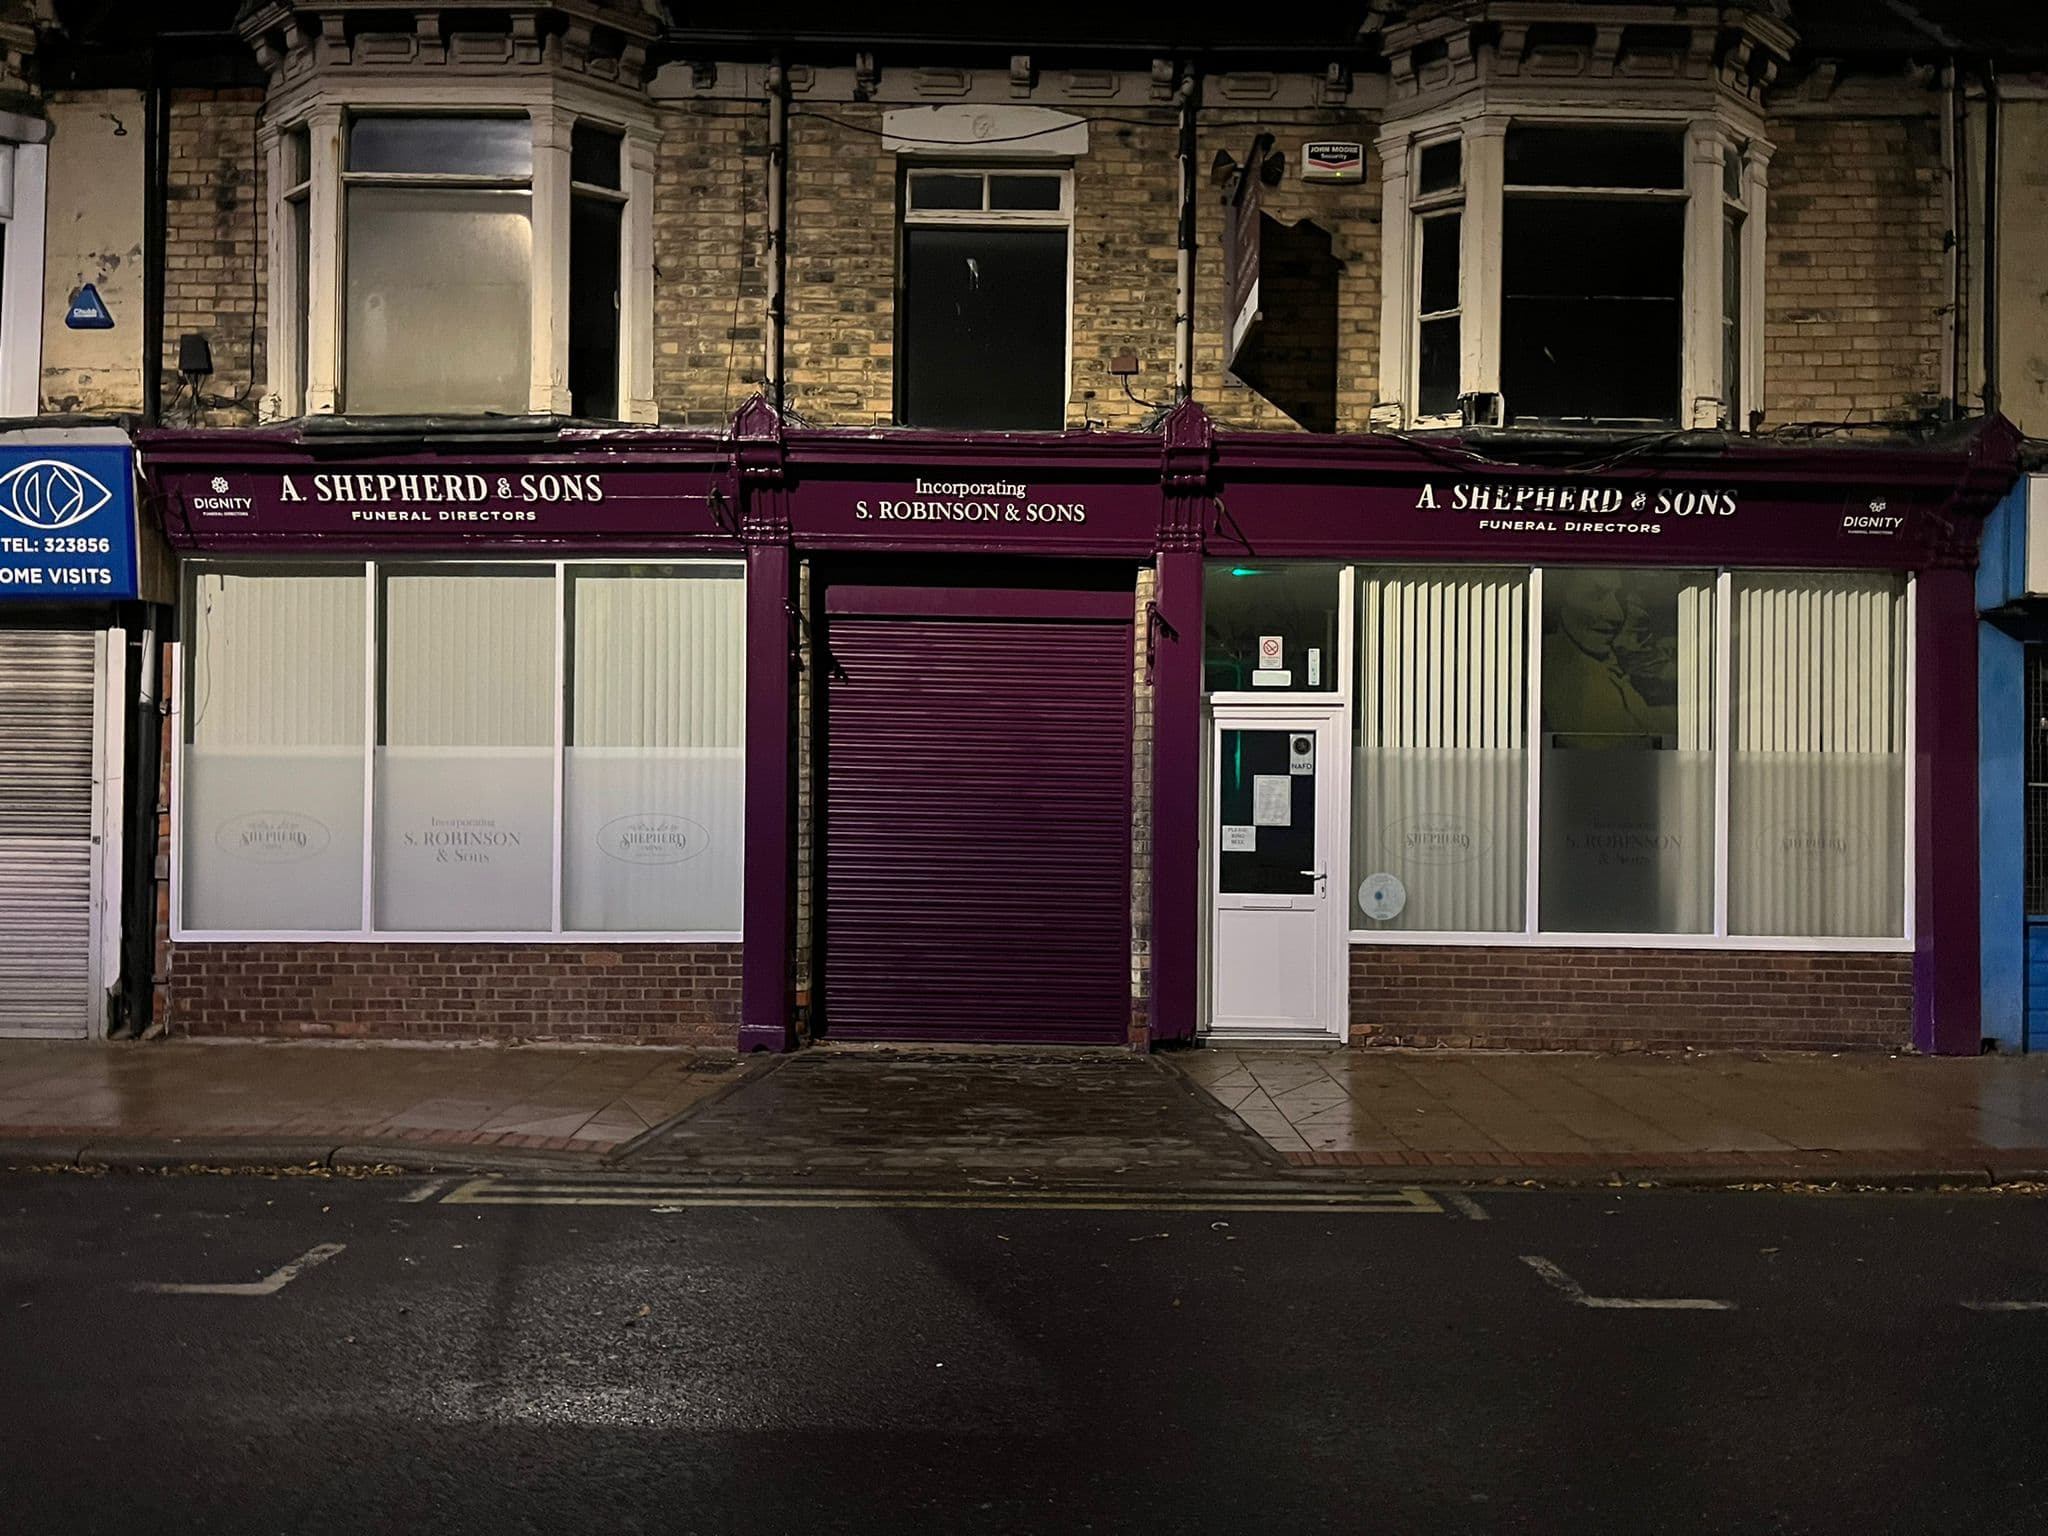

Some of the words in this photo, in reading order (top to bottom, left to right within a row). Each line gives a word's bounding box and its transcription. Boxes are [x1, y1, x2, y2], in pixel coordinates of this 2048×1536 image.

[280, 474, 307, 501] A.
[314, 474, 488, 502] SHEPHERD
[497, 477, 512, 499] &
[520, 474, 603, 502] SONS
[915, 478, 1027, 498] Incorporating
[193, 498, 252, 509] DIGNITY
[1415, 483, 1441, 509] A.
[1451, 483, 1623, 513] SHEPHERD
[1631, 491, 1647, 511] &
[1654, 488, 1738, 516] SONS
[352, 511, 432, 521] FUNERAL
[439, 511, 537, 521] DIRECTORS
[855, 501, 873, 519] S.
[879, 501, 999, 521] ROBINSON
[1005, 503, 1021, 521] &
[1026, 503, 1086, 522] SONS
[1479, 520, 1557, 531] FUNERAL
[1564, 522, 1662, 534] DIRECTORS
[1843, 516, 1904, 528] DIGNITY
[1, 537, 39, 552] TEL:
[44, 537, 110, 553] 323856
[48, 567, 112, 584] VISITS
[423, 832, 520, 847] ROBINSON
[621, 832, 687, 850] SHEPHERD
